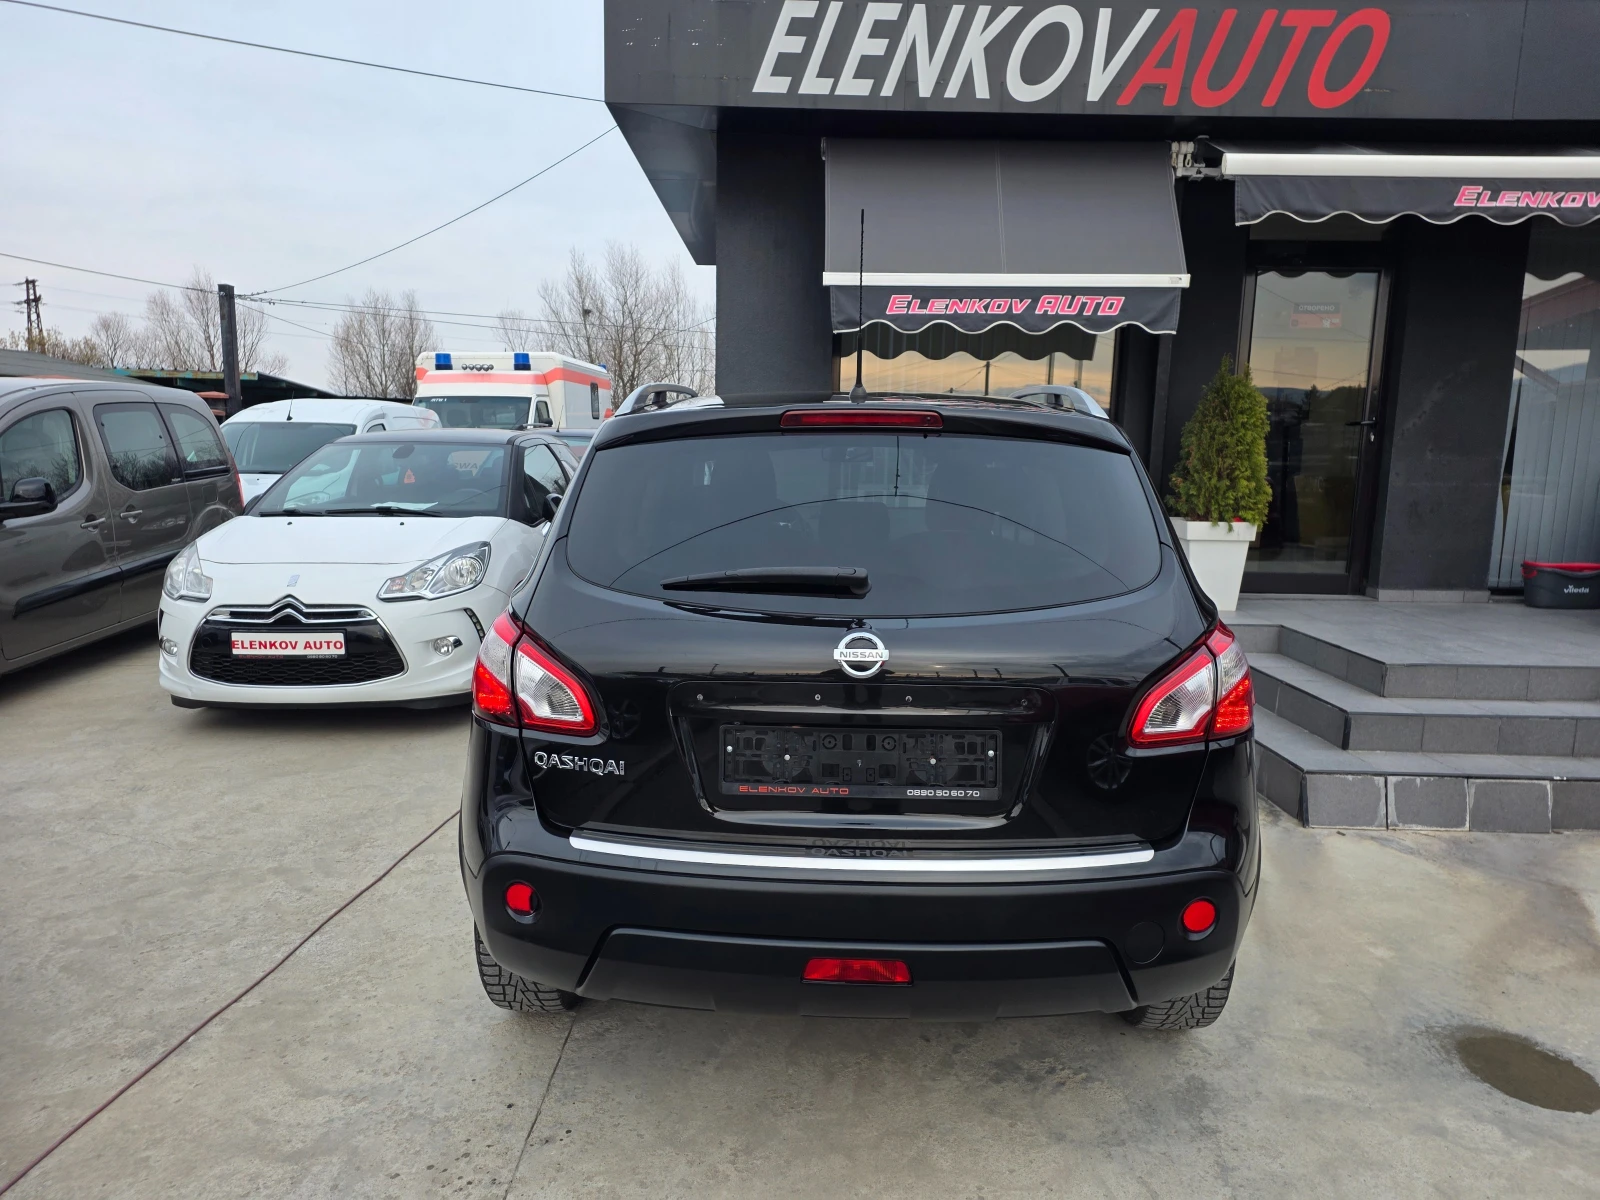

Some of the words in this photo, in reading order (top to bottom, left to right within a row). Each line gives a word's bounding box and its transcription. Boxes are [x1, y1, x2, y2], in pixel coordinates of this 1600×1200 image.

[886, 294, 1031, 314] ELENKOV
[1035, 294, 1126, 315] AUTO
[231, 640, 298, 650] ELENKOV
[303, 640, 344, 650] AUTO
[839, 651, 884, 659] NISSAN
[534, 751, 625, 776] QASHQAI
[739, 785, 806, 794] ELENKOV
[811, 787, 849, 795] AUTO
[811, 847, 907, 858] QASHQAI
